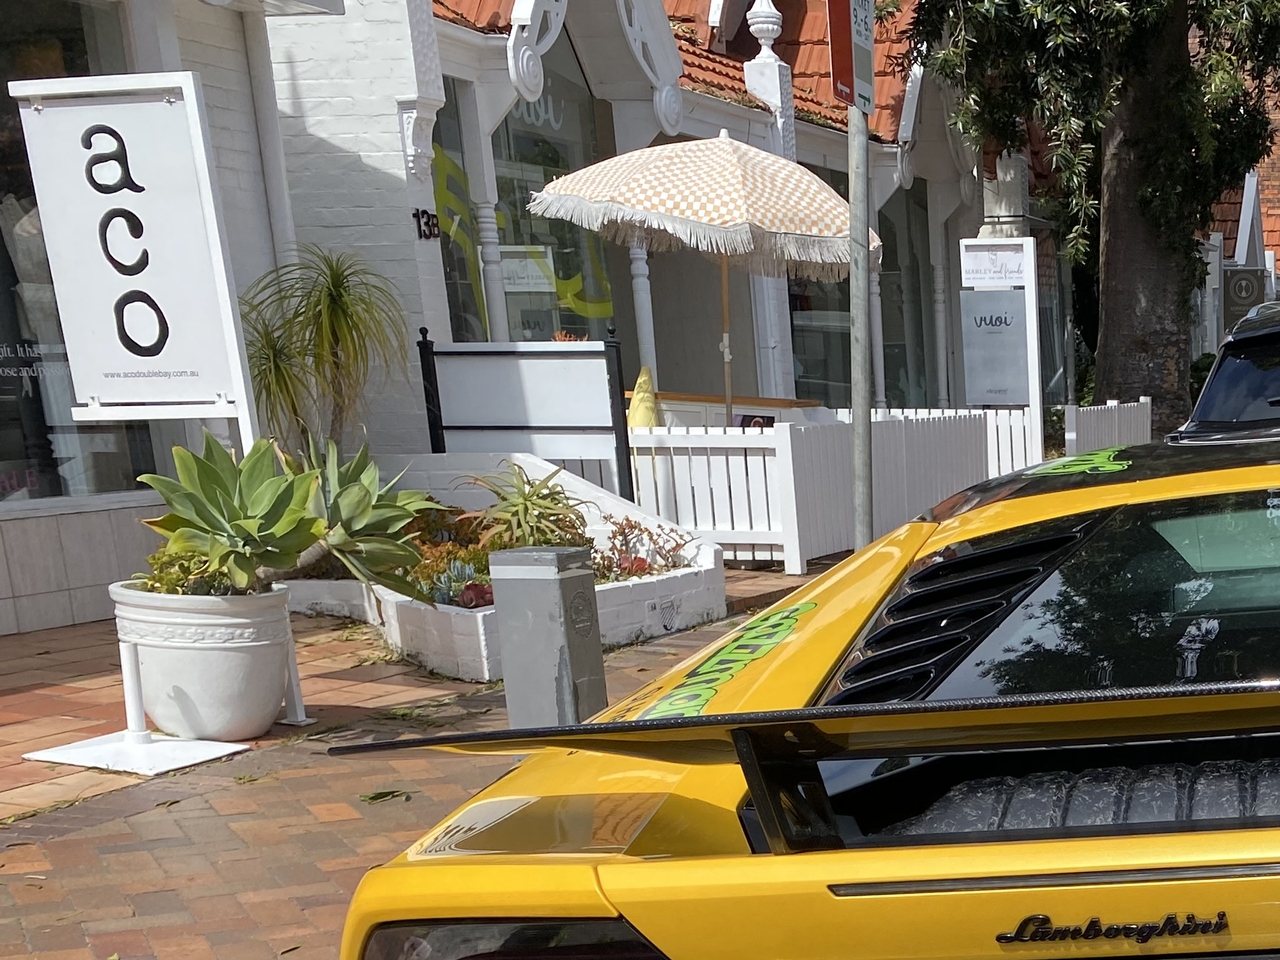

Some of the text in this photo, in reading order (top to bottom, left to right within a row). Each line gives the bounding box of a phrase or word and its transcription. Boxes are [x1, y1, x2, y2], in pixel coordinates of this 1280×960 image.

[412, 207, 440, 239] 13B
[81, 124, 170, 358] aco
[973, 311, 1014, 328] vuoi
[18, 362, 38, 377] and
[102, 369, 199, 380] www.acodoublebay.com.au
[995, 911, 1230, 944] Lamborghini
